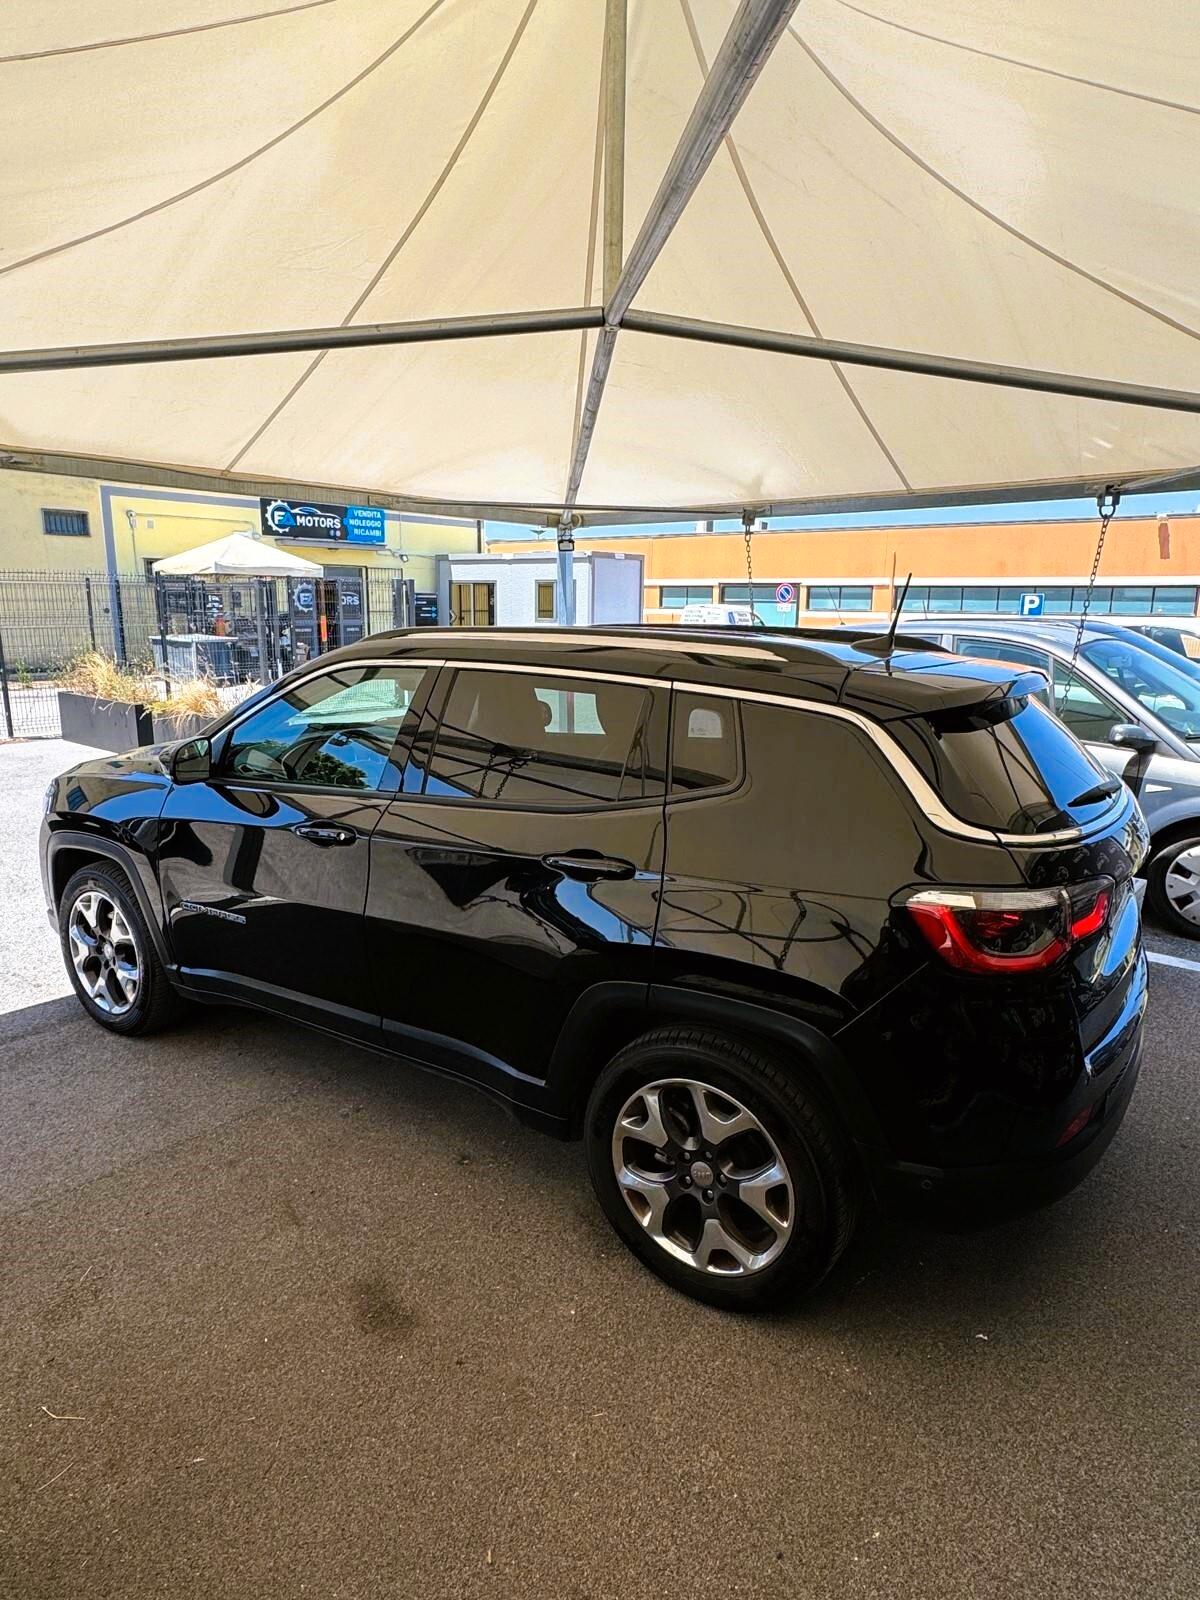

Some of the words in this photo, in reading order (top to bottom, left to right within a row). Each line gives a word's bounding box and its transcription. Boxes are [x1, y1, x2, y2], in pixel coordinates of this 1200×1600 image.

[353, 510, 382, 519] VENDITA
[297, 516, 341, 528] MOTORS
[349, 518, 382, 527] NOLEGGIO
[354, 528, 382, 537] RICAMBI
[1023, 596, 1040, 615] P
